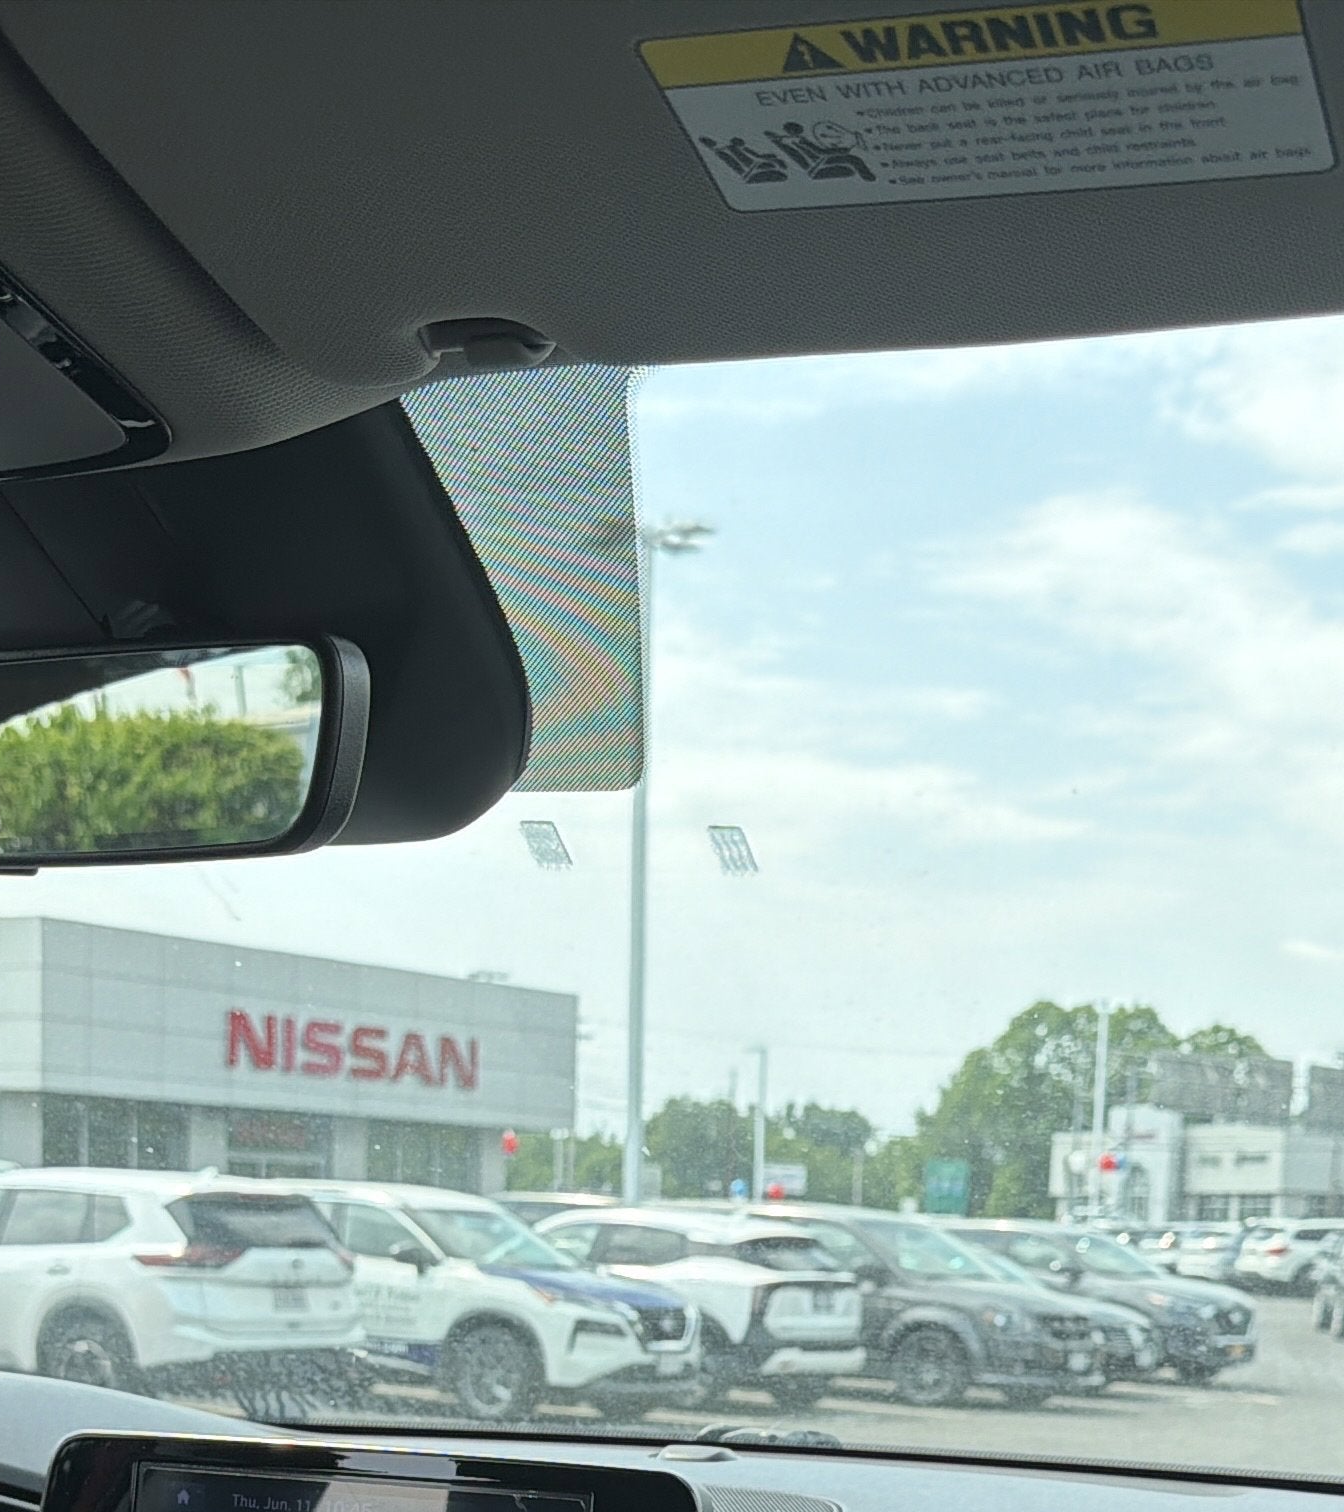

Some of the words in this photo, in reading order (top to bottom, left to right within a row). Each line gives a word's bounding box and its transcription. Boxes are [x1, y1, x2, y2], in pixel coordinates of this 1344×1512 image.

[840, 4, 1159, 62] WARNING
[756, 86, 828, 107] EVEN
[837, 79, 905, 101] WITH
[918, 66, 1064, 93] ADVANCED
[1078, 60, 1123, 80] AIR
[1135, 53, 1215, 76] BAGS
[226, 1008, 481, 1090] NISSAN
